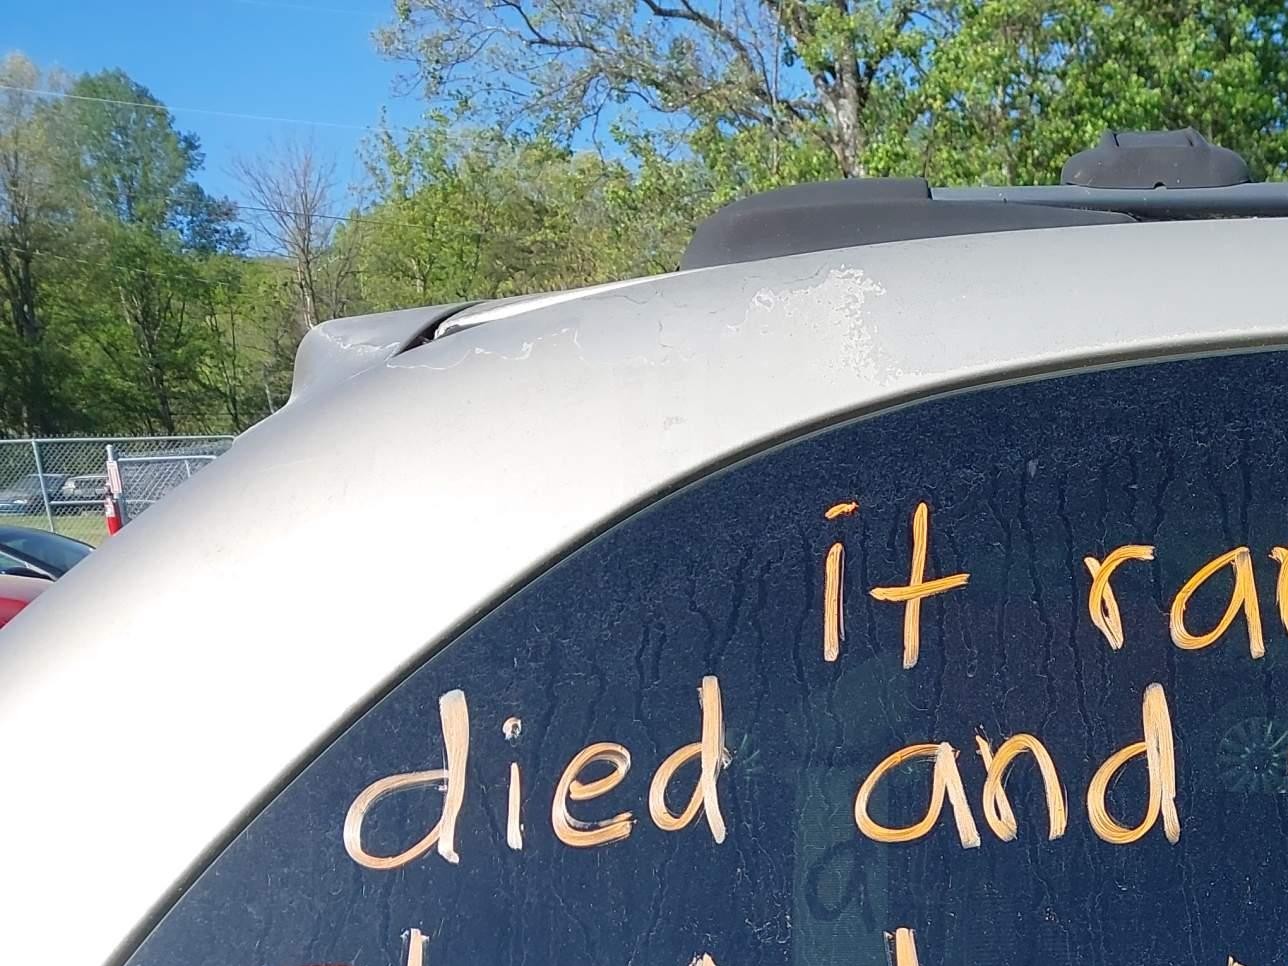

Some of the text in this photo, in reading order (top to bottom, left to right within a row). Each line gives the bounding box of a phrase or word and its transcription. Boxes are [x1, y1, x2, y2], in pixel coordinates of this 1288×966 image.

[823, 500, 970, 669] it
[342, 675, 732, 870] died
[854, 682, 1181, 846] and
